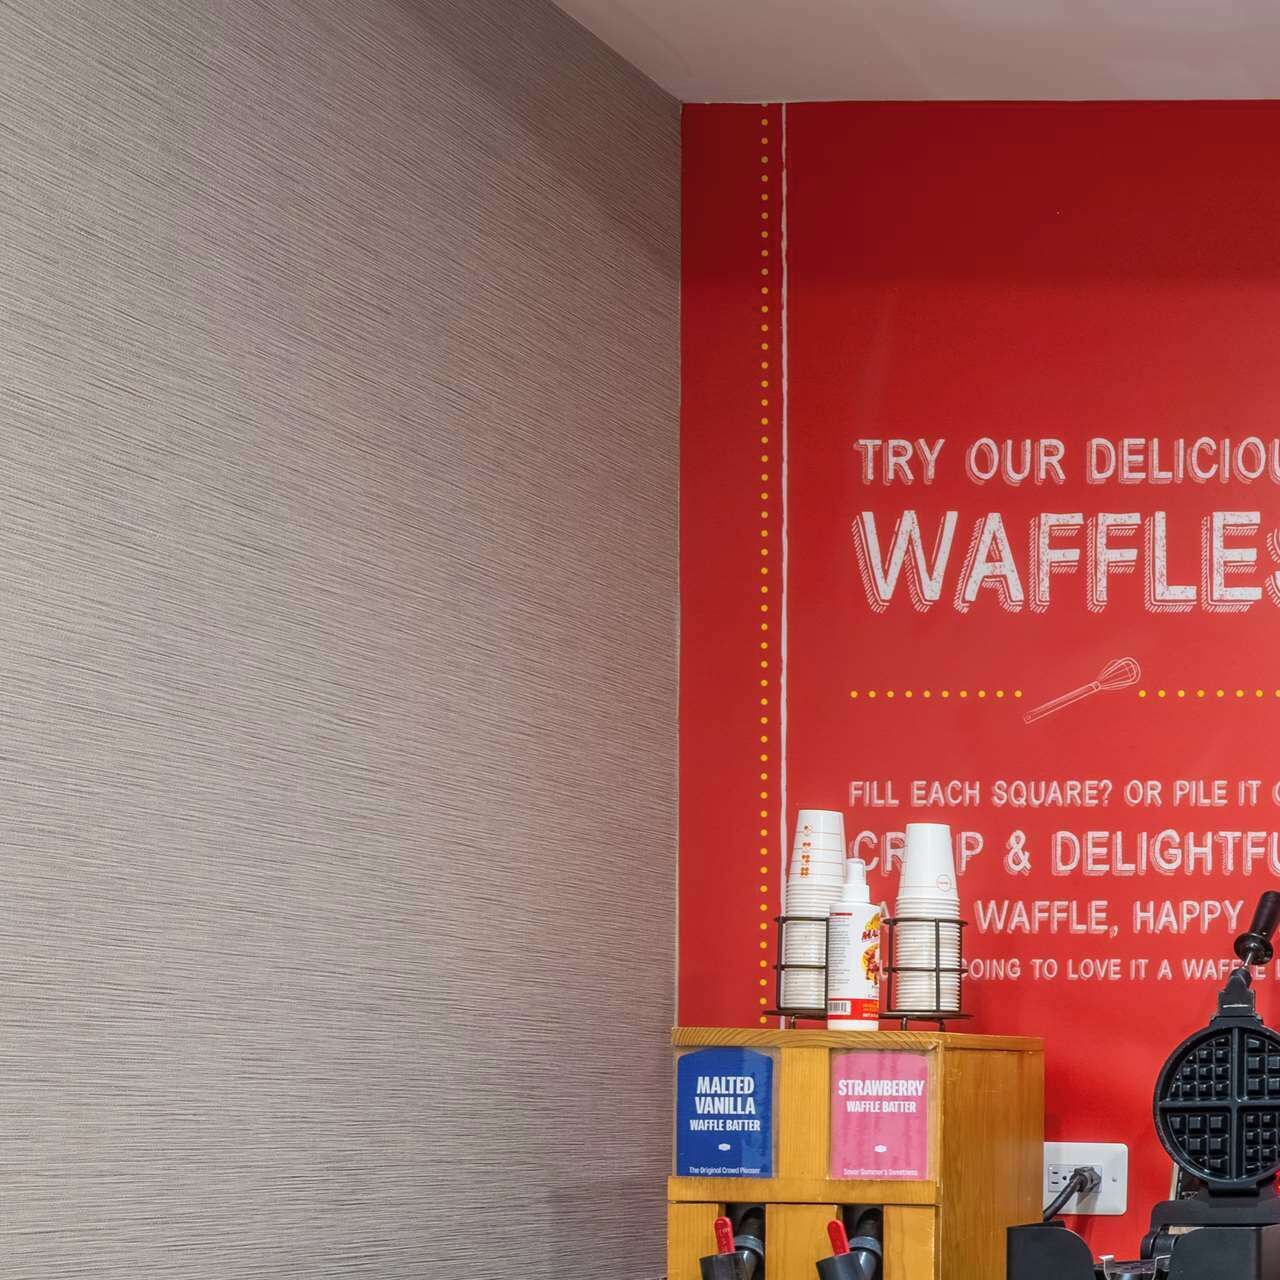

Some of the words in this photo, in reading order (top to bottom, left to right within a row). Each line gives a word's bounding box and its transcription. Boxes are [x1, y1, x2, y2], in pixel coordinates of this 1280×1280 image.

[853, 437, 945, 484] TRY
[967, 437, 1066, 484] OUR
[849, 780, 900, 807] FILL
[910, 780, 981, 807] EACH
[991, 780, 1113, 807] SQUARE?
[1123, 780, 1163, 807] OR
[1173, 780, 1228, 807] PILE
[1238, 780, 1262, 807] IT
[852, 830, 985, 876] CRP
[1004, 829, 1032, 877] &
[974, 899, 1119, 939] WAFFLE,
[1132, 899, 1245, 935] HAPPY
[1030, 957, 1059, 981] TO
[1066, 957, 1122, 981] LOVE
[1129, 958, 1149, 981] IT
[1156, 958, 1174, 981] A
[1181, 957, 1267, 981] WAFFE
[695, 1076, 756, 1096] MALTED
[838, 1079, 926, 1097] STRAWBERRY
[694, 1096, 757, 1116] VANILLA
[846, 1100, 881, 1114] WAFFLE
[881, 1100, 917, 1114] BATTER
[689, 1119, 725, 1132] WAFFLE
[725, 1119, 761, 1132] BATTER
[689, 1166, 699, 1174] The
[700, 1166, 721, 1175] Original
[721, 1166, 740, 1175] Crowd
